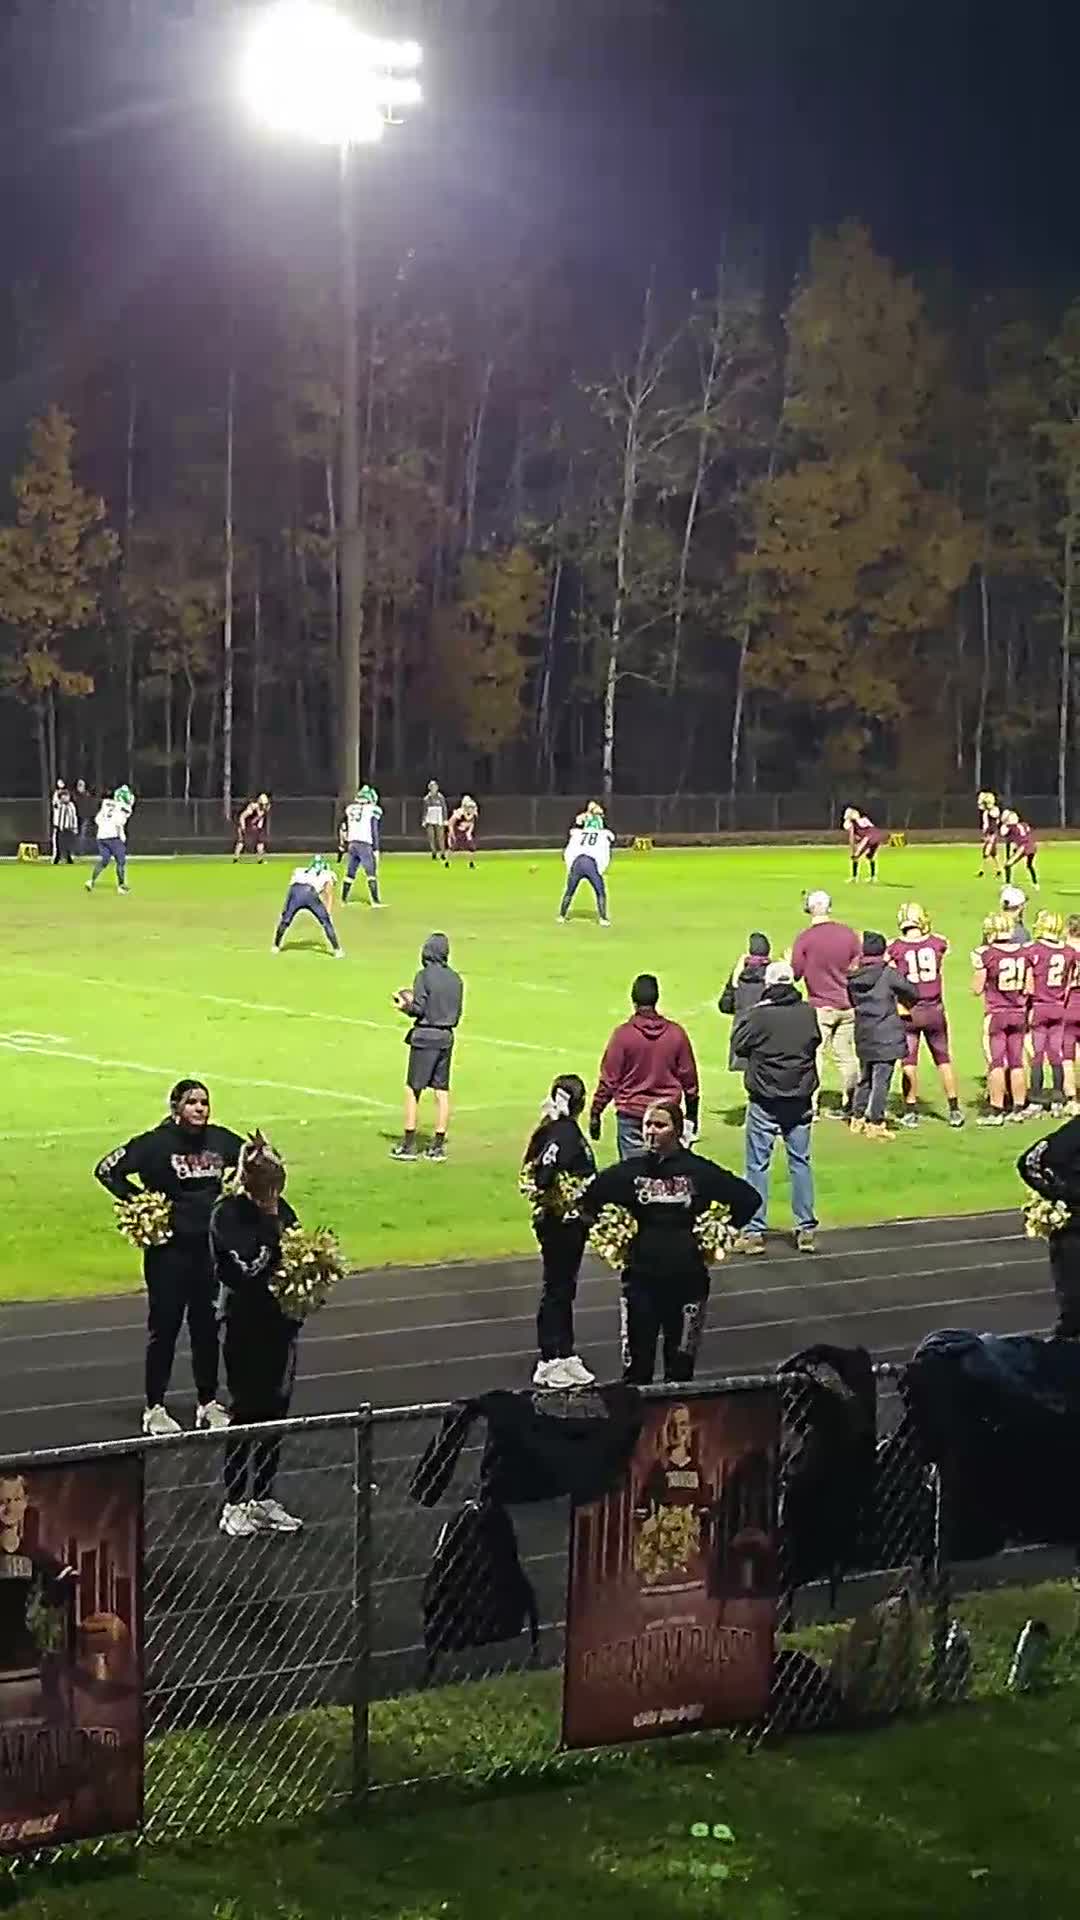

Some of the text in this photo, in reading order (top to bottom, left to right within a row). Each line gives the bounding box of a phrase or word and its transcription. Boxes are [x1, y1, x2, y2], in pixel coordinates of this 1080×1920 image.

[580, 832, 599, 846] 78
[904, 947, 938, 984] 19
[999, 957, 1026, 991] 21
